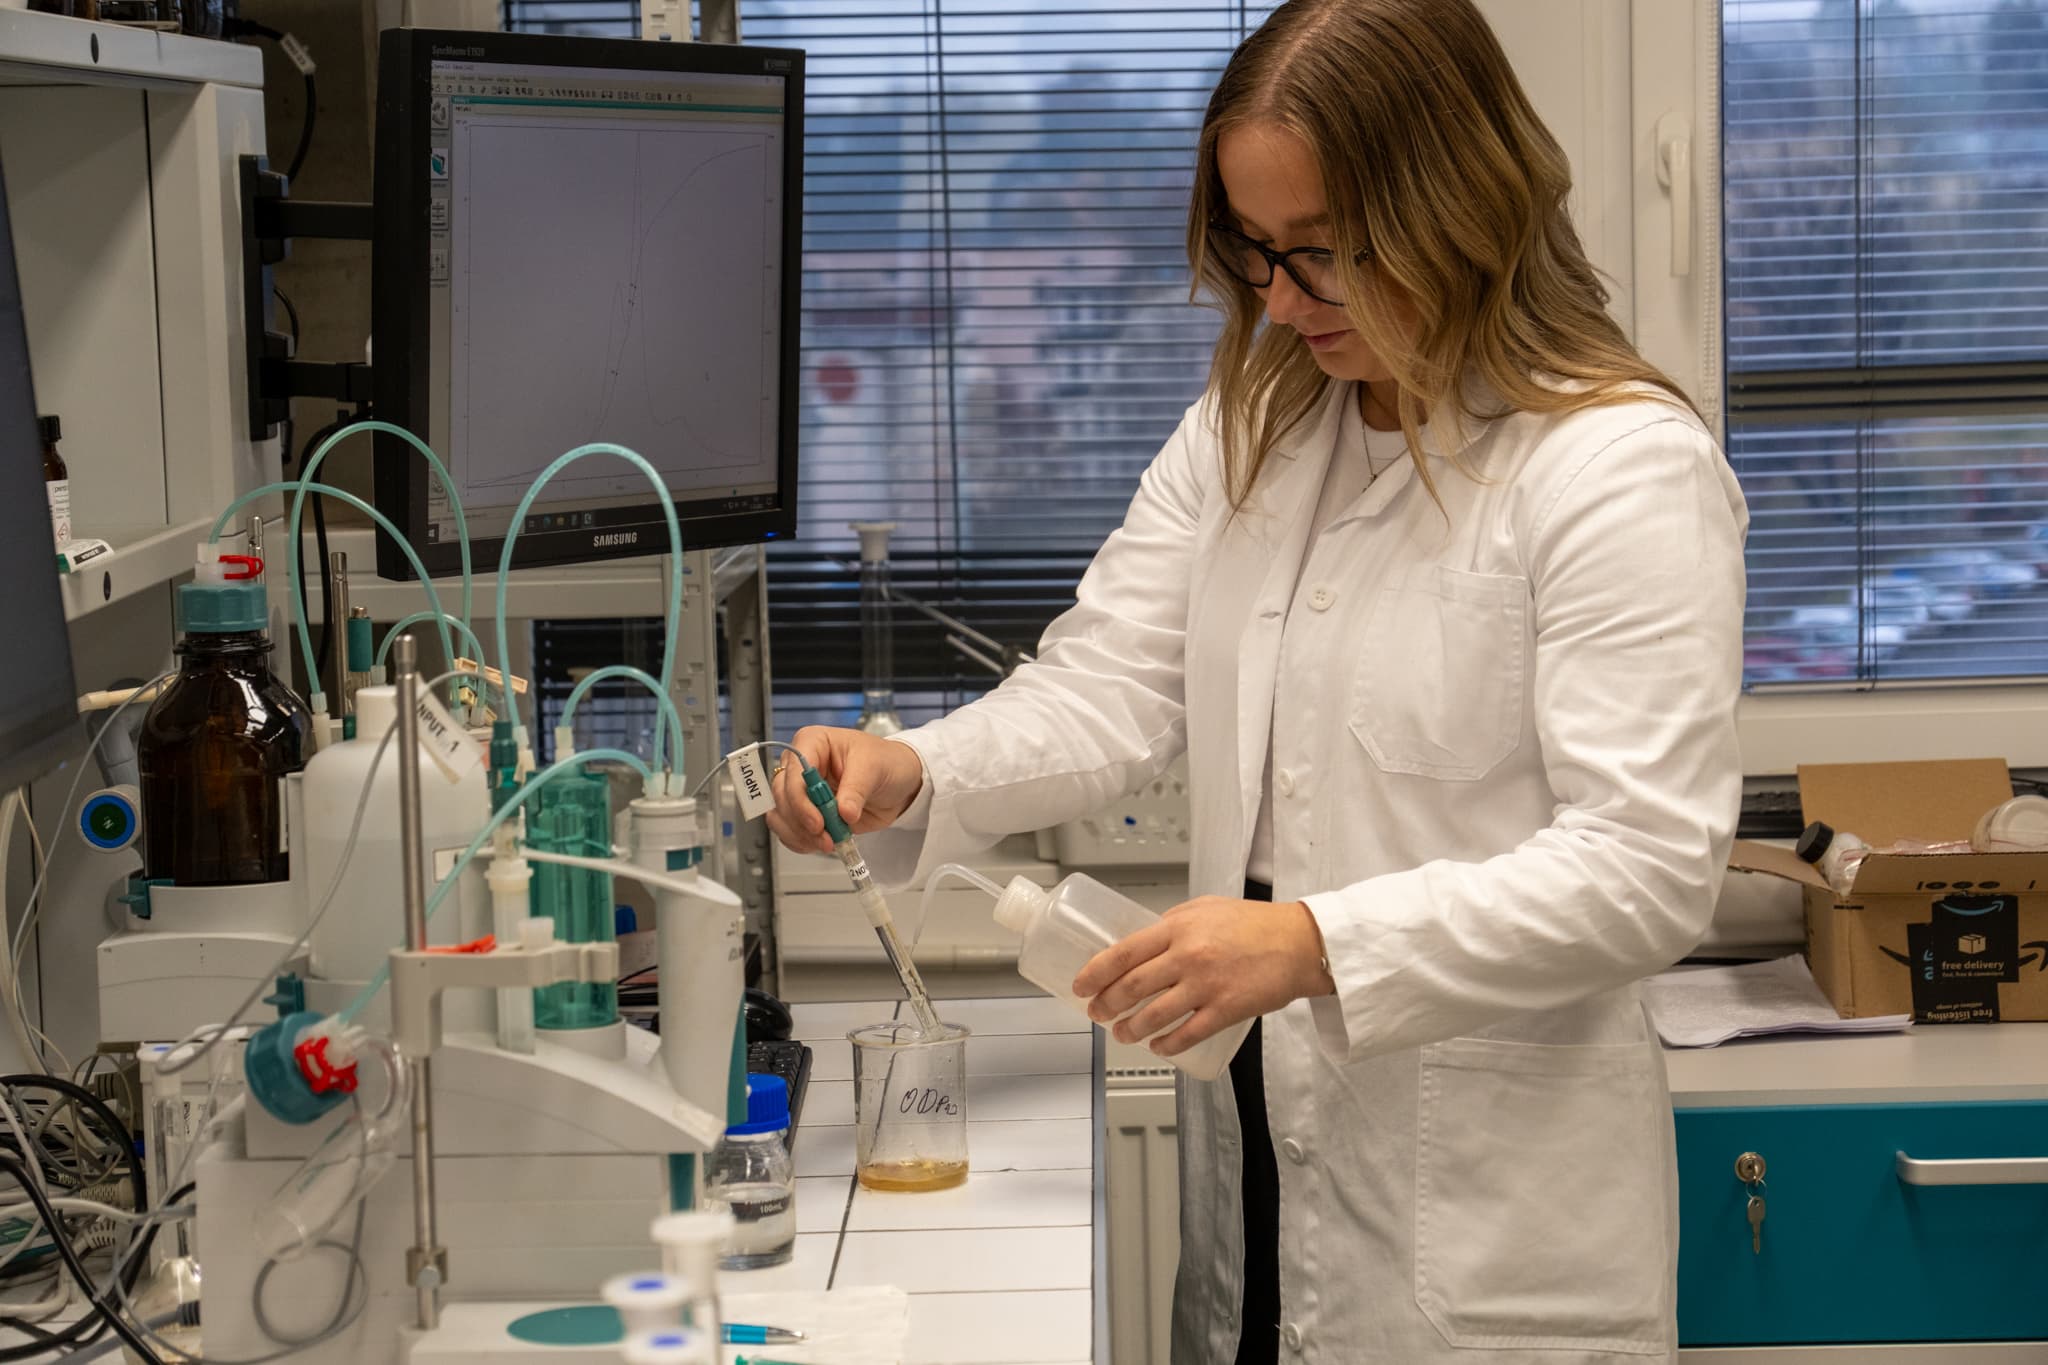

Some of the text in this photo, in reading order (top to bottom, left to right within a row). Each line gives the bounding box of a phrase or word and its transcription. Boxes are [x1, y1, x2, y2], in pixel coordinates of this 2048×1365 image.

[593, 531, 637, 548] SAMSUNG
[416, 703, 447, 737] NPUT
[741, 763, 762, 800] INPUT
[1942, 959, 2005, 971] free delivery
[1927, 1008, 1993, 1021] free listening
